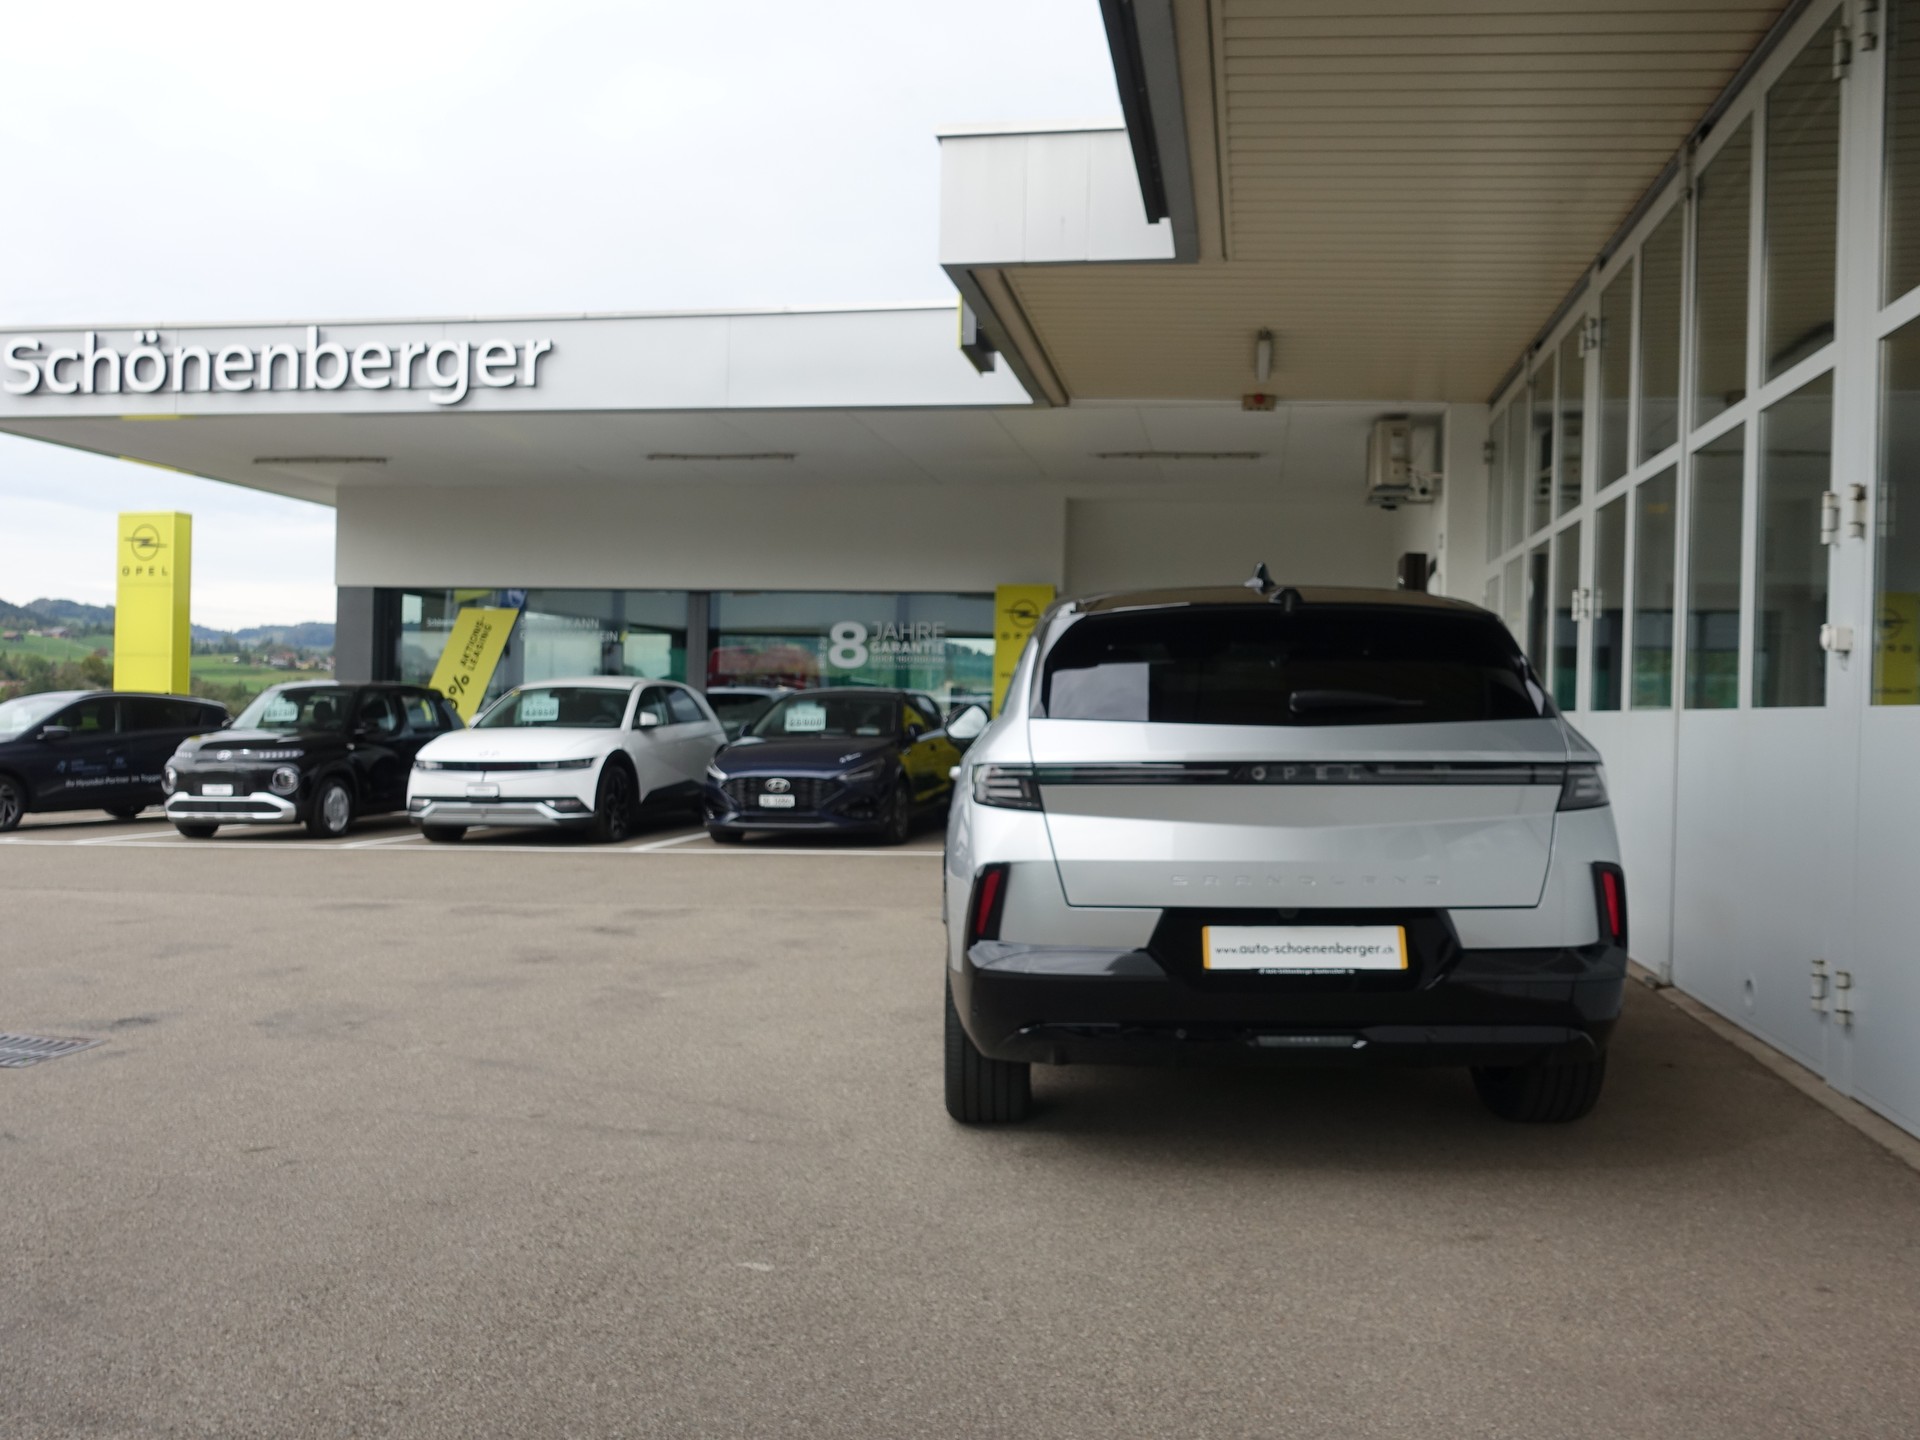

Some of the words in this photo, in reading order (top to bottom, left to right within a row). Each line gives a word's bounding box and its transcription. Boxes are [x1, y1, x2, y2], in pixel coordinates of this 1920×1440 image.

[3, 325, 553, 405] Schönenberger
[122, 565, 168, 577] OPEL
[467, 623, 493, 672] LEASING
[828, 621, 868, 669] 8
[871, 620, 945, 641] JAHRE
[1251, 765, 1361, 781] OPEL
[1215, 942, 1394, 958] www.auto-schoenenberger.ch
